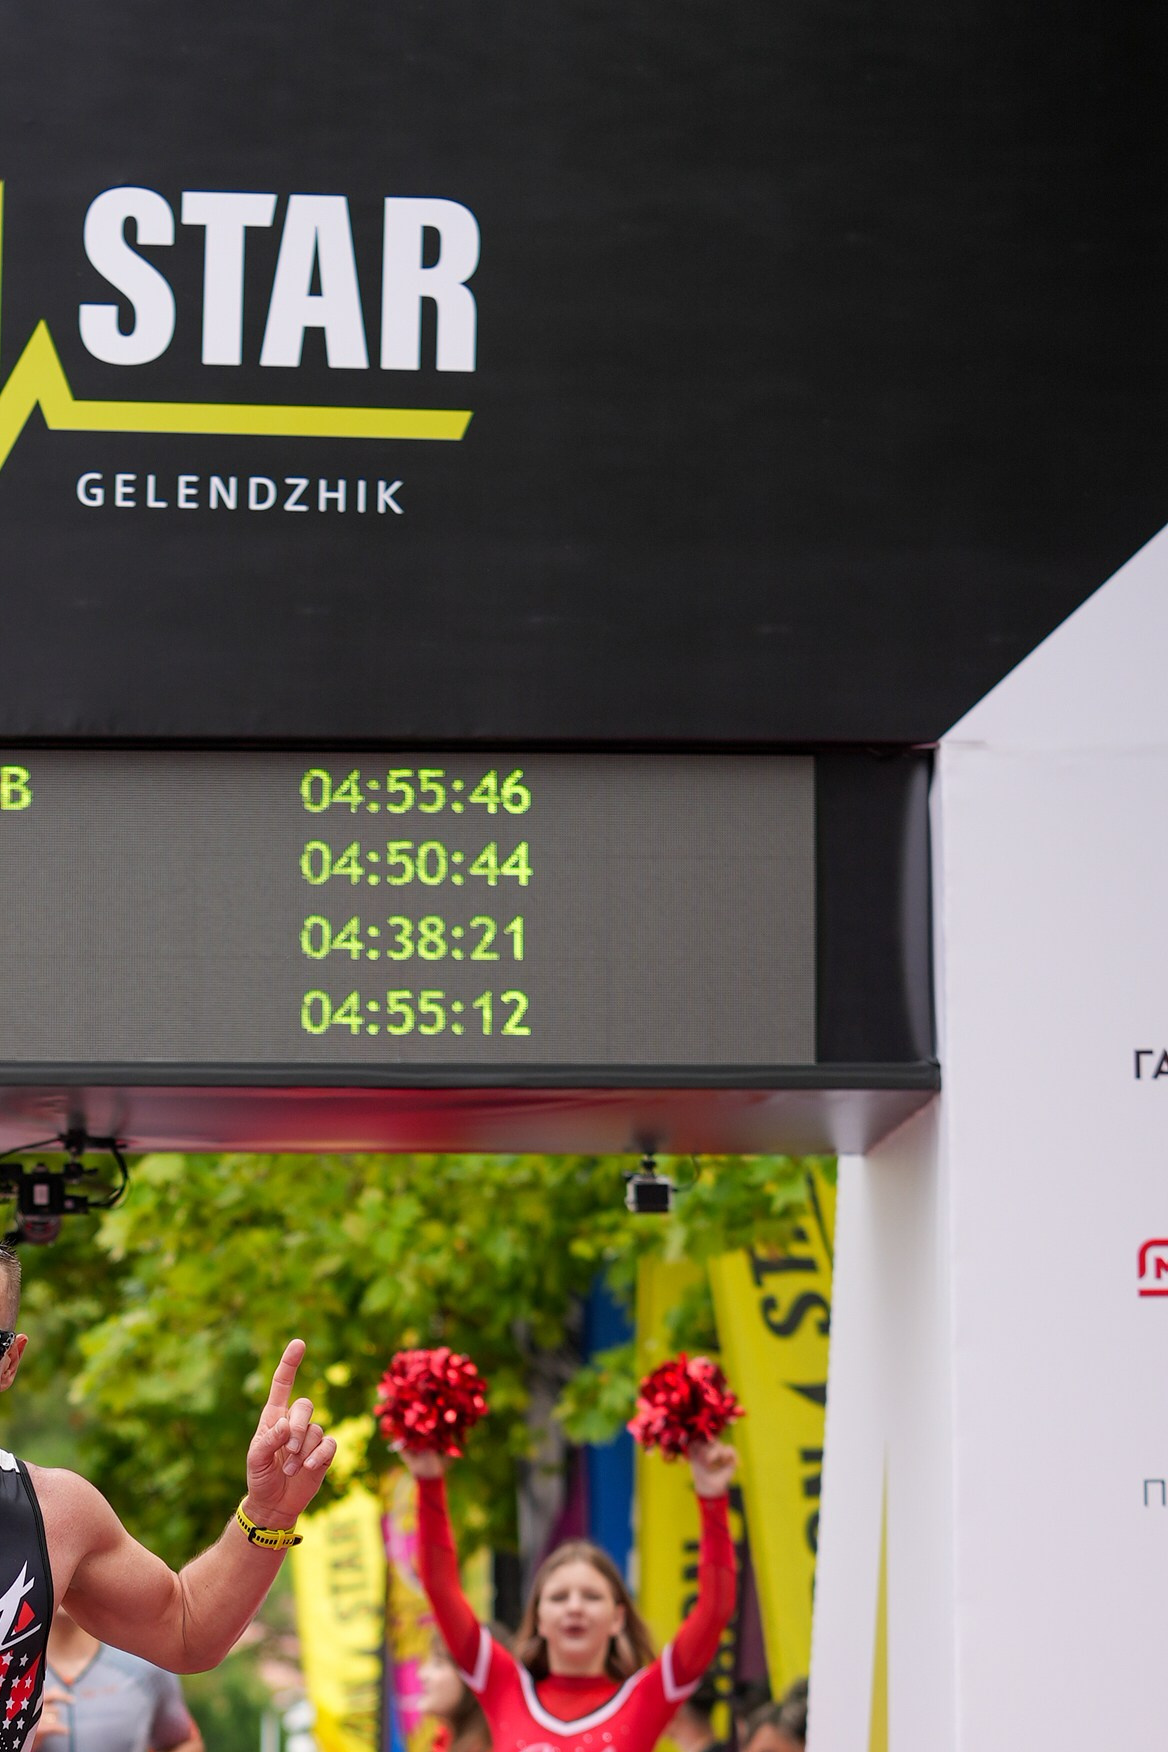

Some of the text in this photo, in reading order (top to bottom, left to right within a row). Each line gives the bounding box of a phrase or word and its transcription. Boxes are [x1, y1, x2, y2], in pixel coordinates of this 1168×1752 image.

[79, 187, 481, 372] STAR
[76, 473, 405, 515] GELENDZHIK
[299, 768, 532, 815] 04:55:46
[299, 838, 534, 886] 04:50:44
[299, 914, 526, 961] 04:38:21
[299, 988, 532, 1036] 04:55:12
